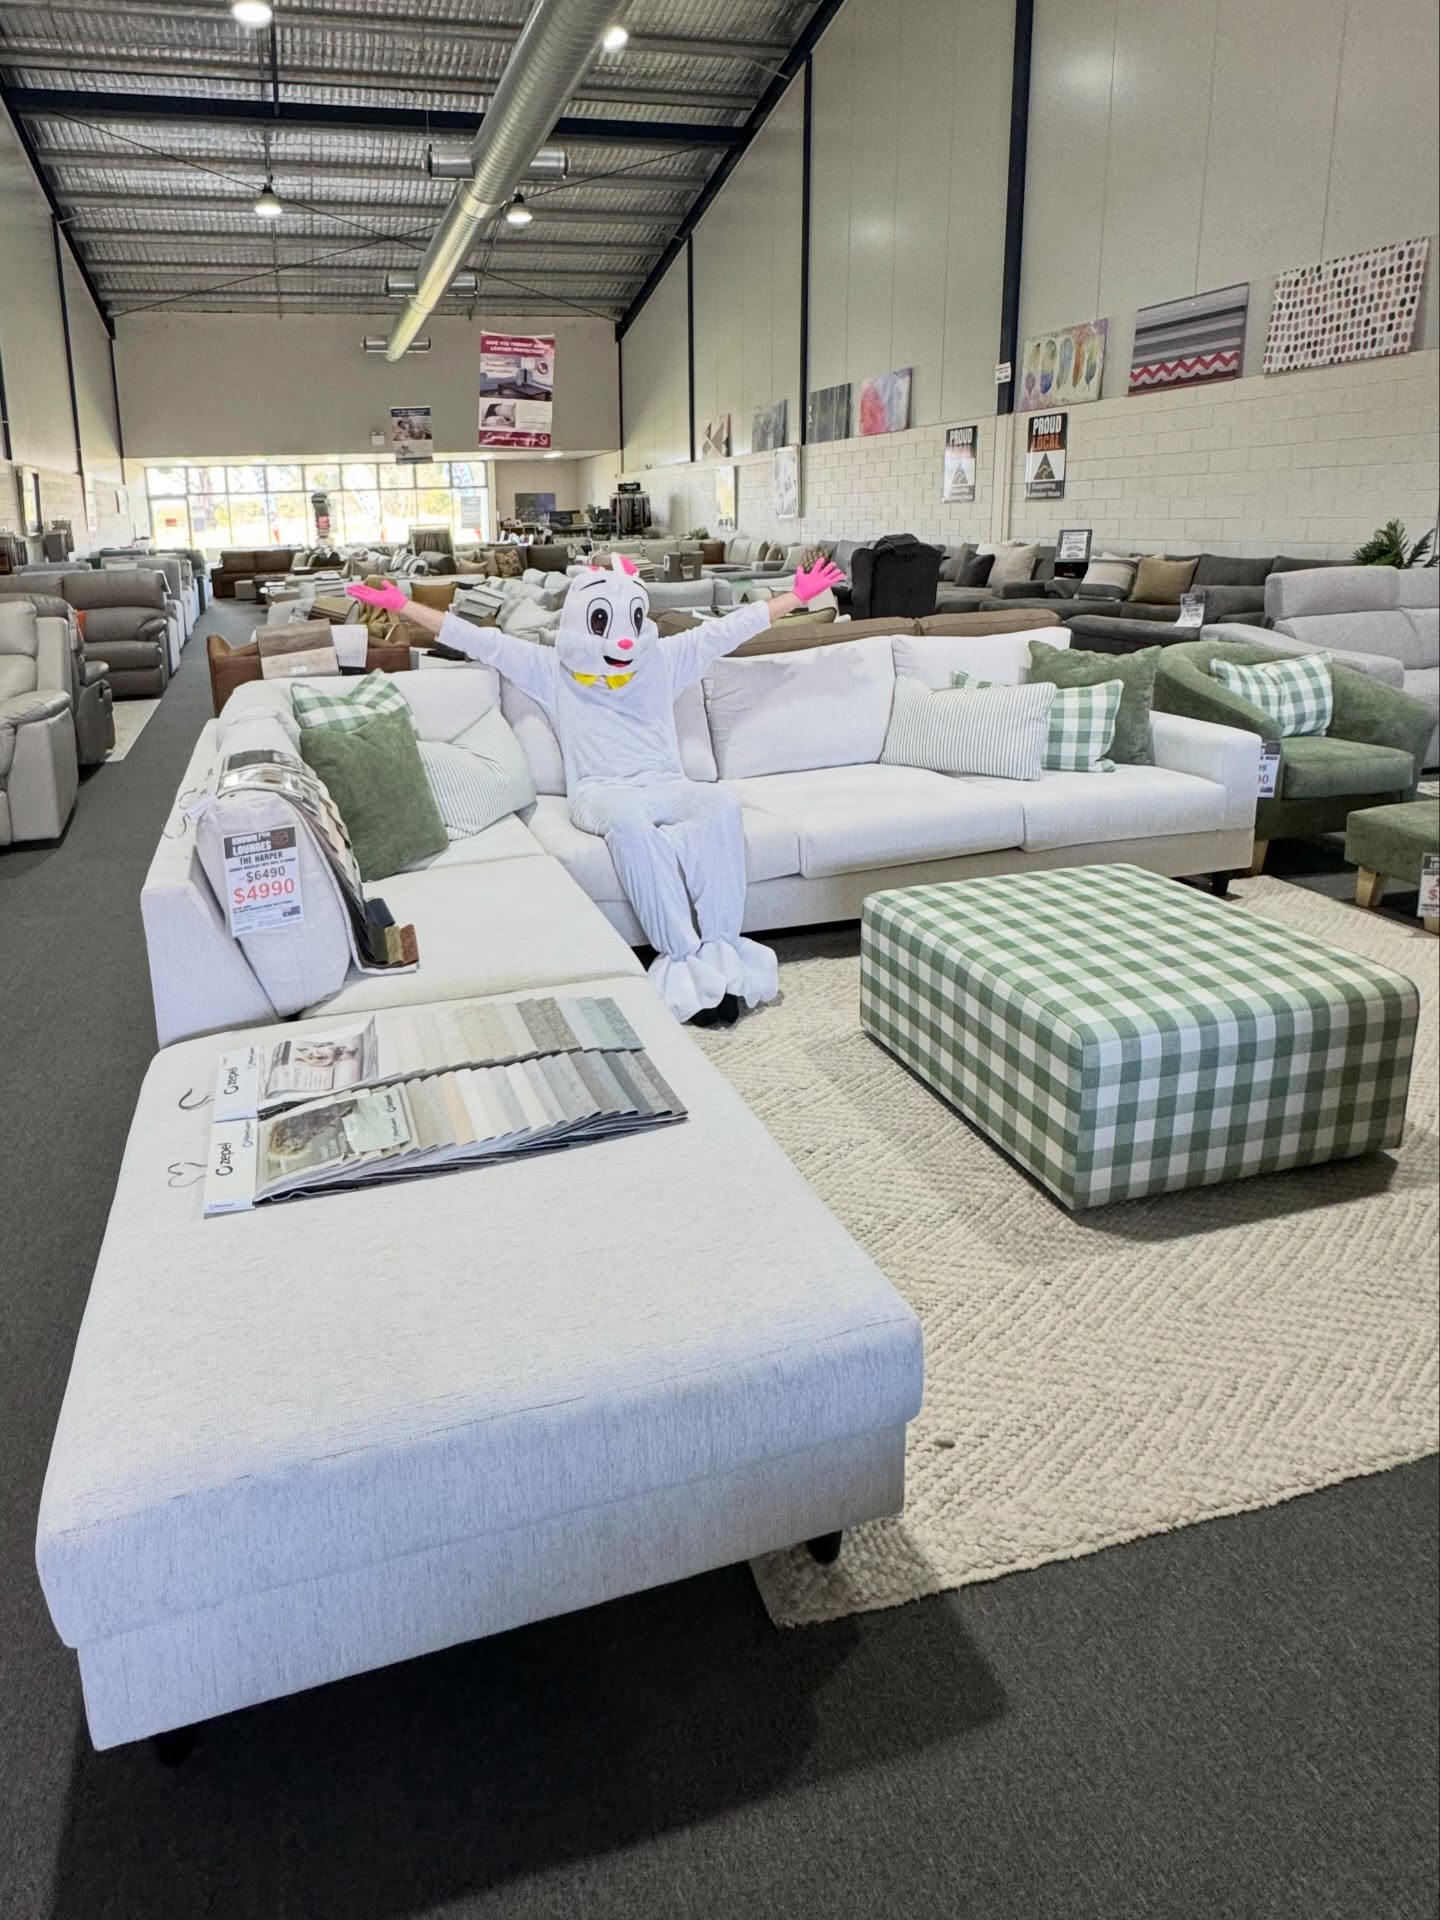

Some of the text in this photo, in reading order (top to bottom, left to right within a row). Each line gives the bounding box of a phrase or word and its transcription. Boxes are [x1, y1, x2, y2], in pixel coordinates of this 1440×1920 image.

[1033, 415, 1062, 436] PROUD
[949, 428, 973, 446] PROUD
[1031, 434, 1061, 450] LOCAL
[232, 840, 272, 856] LOUNGES
[239, 856, 253, 866] THE
[254, 851, 284, 863] HARPER
[246, 865, 286, 883] $6490
[234, 878, 295, 905] $4990
